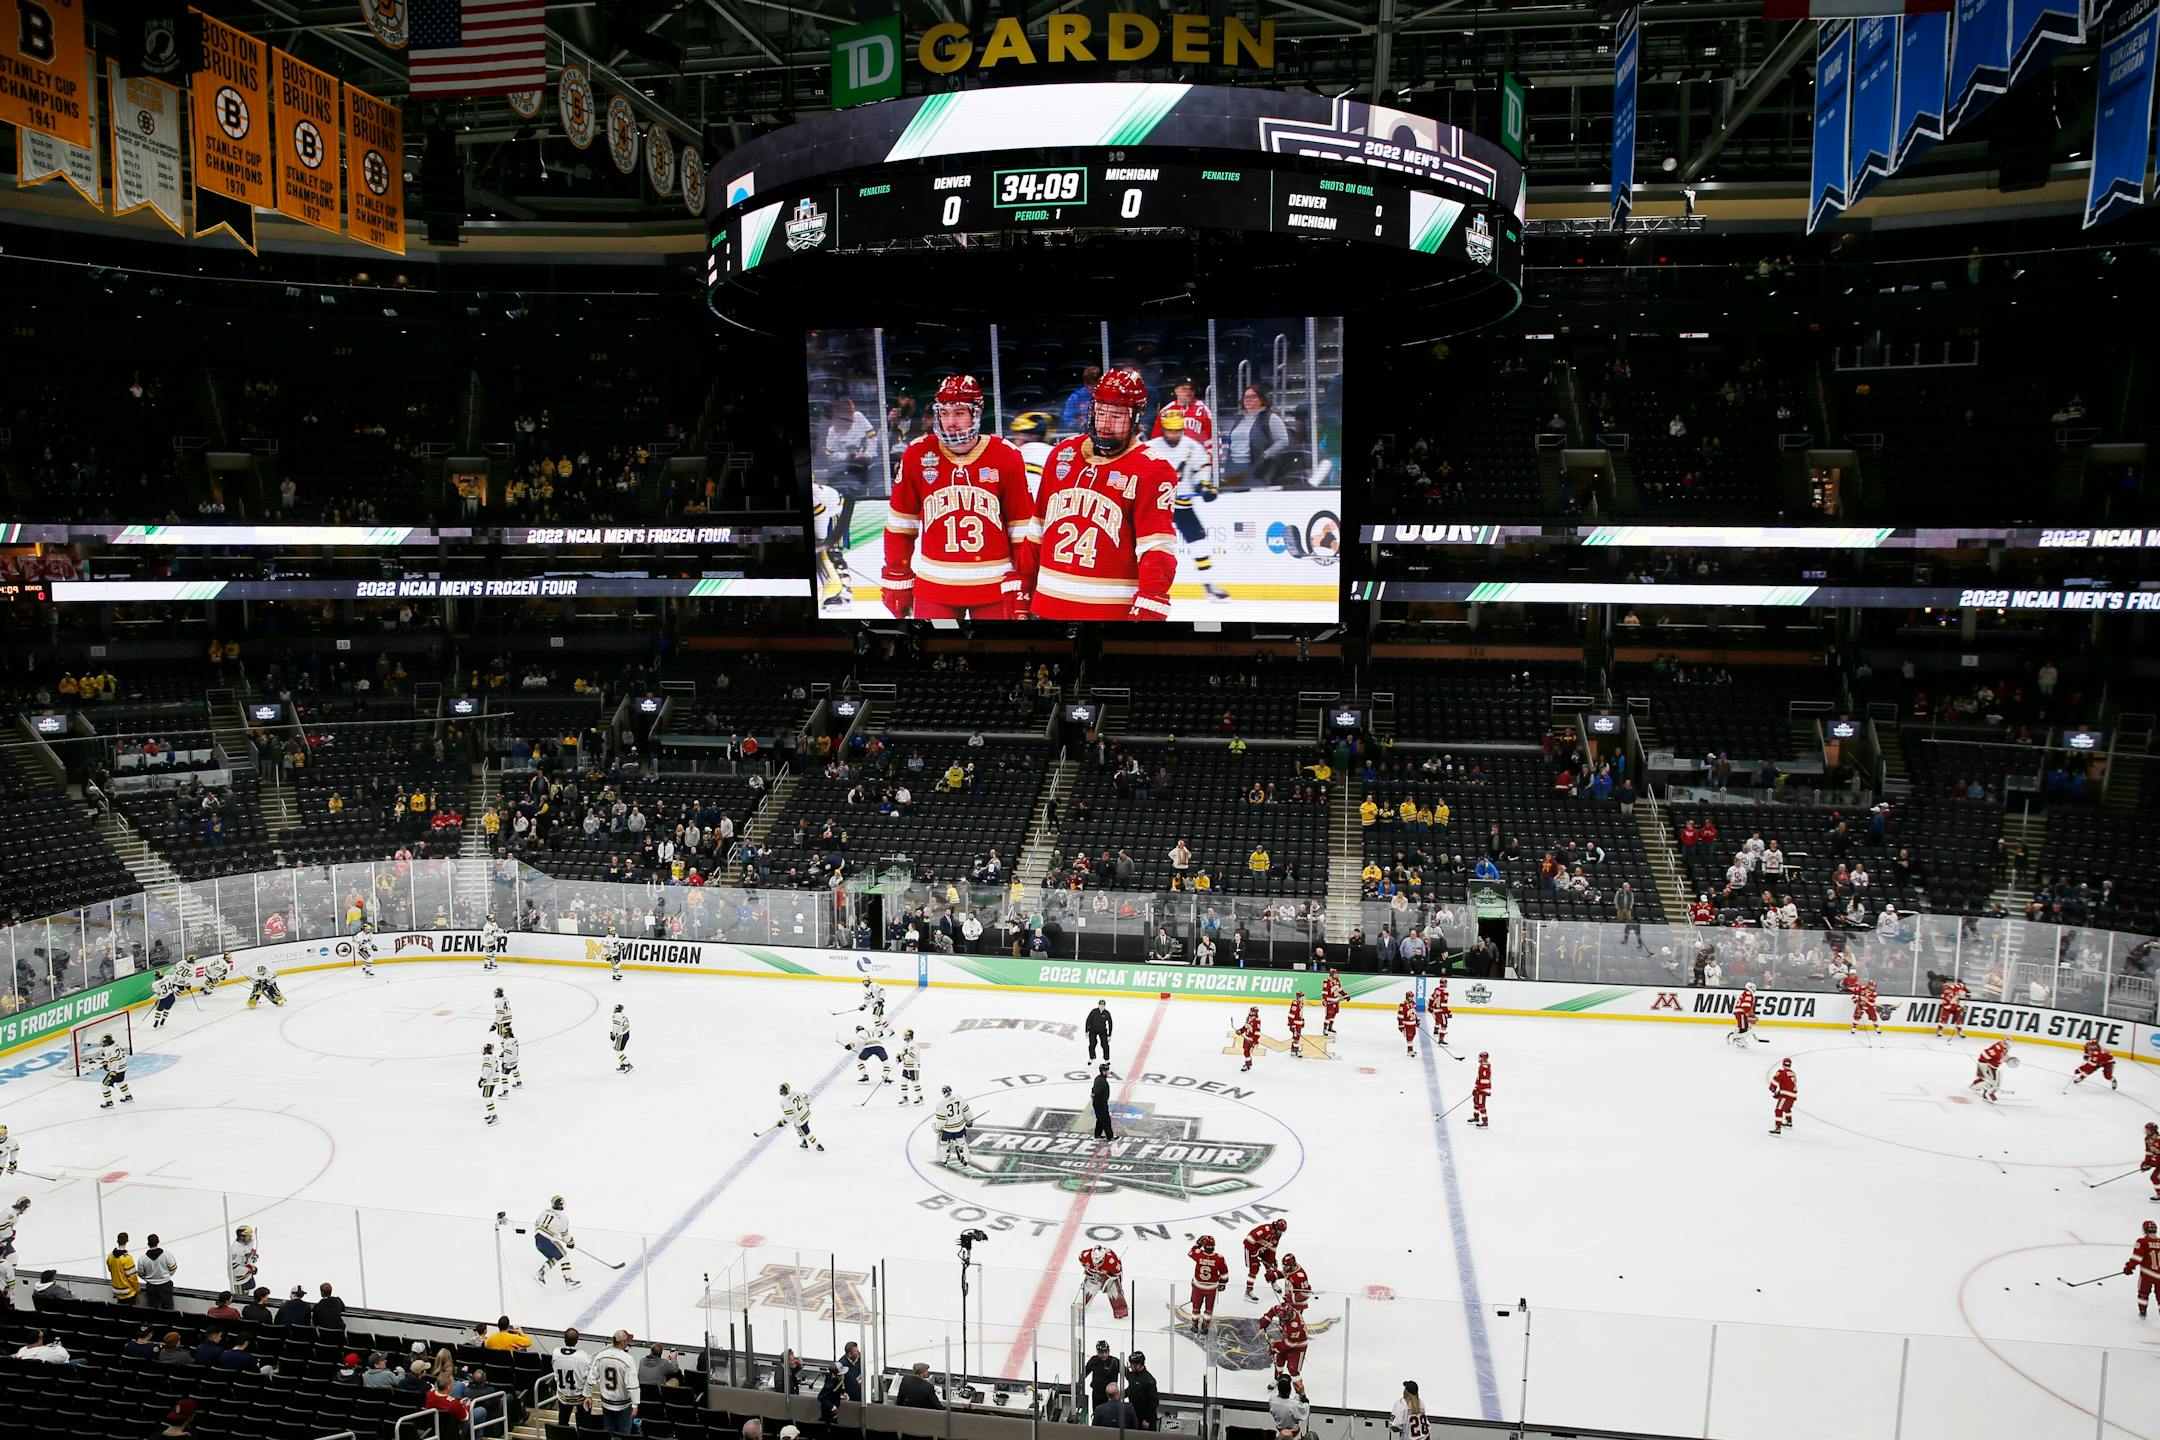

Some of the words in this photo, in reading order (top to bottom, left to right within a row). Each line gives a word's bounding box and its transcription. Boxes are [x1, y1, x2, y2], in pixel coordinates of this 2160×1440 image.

[201, 19, 257, 65] BOSTON
[836, 34, 894, 90] TD
[918, 12, 1275, 74] GARDEN
[0, 55, 53, 88] STANLEY
[56, 78, 77, 97] CUP
[201, 48, 258, 92] BRUINS
[282, 57, 331, 100] BOSTON
[0, 77, 79, 120] CHAMPIONS
[283, 86, 332, 125] BRUINS
[352, 92, 396, 130] BOSTON
[28, 107, 56, 131] 1941
[1504, 85, 1522, 143] TD
[353, 116, 396, 153] BRUINS
[206, 136, 245, 161] STANLEY
[246, 149, 261, 167] CUP
[1364, 142, 1401, 160] 2022
[1403, 149, 1441, 169] MEN'S
[206, 155, 263, 185] CHAMPIONS
[286, 165, 319, 193] STANLEY
[320, 178, 334, 193] CUP
[934, 175, 972, 190] DENVER
[1105, 168, 1159, 181] MICHIGAN
[1202, 170, 1240, 181] PENALTIES
[225, 177, 247, 197] 1970
[286, 182, 335, 212] CHAMPIONS
[859, 184, 890, 197] PENALTIES
[1002, 173, 1079, 202] 34:09
[1320, 180, 1345, 191] SHOTS
[1345, 183, 1356, 193] ON
[1356, 184, 1374, 196] GOAL
[302, 204, 320, 222] 1972
[356, 193, 383, 217] STANLEY
[384, 205, 398, 218] CUP
[942, 196, 961, 227] 0
[1015, 210, 1050, 221] PERIOD:
[1055, 207, 1061, 220] 1
[1121, 189, 1143, 219] 0
[1289, 194, 1327, 210] DENVER
[1375, 205, 1383, 218] 0
[356, 209, 399, 235] CHAMPIONS
[1289, 214, 1337, 231] MICHIGAN
[1375, 225, 1382, 237] 0
[370, 228, 386, 244] 2011
[1122, 475, 1138, 500] A
[923, 485, 1003, 533] DENVER
[1044, 487, 1123, 549] DENVER
[527, 530, 563, 544] 2022
[566, 529, 601, 544] NCAA
[604, 529, 645, 544] MEN'S
[648, 528, 695, 543] FROZEN
[697, 528, 731, 542] FOUR
[944, 516, 984, 552] 13
[1054, 522, 1098, 568] 24
[2039, 530, 2090, 547] 2022
[2092, 530, 2142, 547] NCAA
[357, 582, 397, 597] 2022
[399, 581, 437, 596] NCAA
[440, 581, 483, 596] MEN'S
[485, 580, 538, 595] FROZEN
[541, 580, 577, 595] FOUR
[1016, 592, 1031, 600] 24
[1960, 590, 2011, 608] 2022
[2013, 591, 2061, 609] NCAA
[2063, 591, 2124, 610] MEN'S
[395, 935, 434, 954] DENVER
[441, 935, 508, 953] DENVR
[621, 943, 702, 965] MICHIGAN
[177, 966, 188, 977] 20
[1039, 966, 1081, 984] 2022
[1085, 967, 1126, 986] NCAA
[1132, 971, 1182, 989] MEN'S
[1186, 973, 1249, 993] FROZEN
[1252, 976, 1294, 994] FOUR
[160, 981, 173, 994] 34
[21, 1003, 73, 1038] FROZEN
[76, 991, 110, 1018] FOUR
[1650, 991, 1684, 1012] M
[1693, 993, 1816, 1018] MINESOTA
[950, 1018, 1079, 1041] DENVER
[2048, 1015, 2124, 1046] STATE
[991, 1074, 1047, 1090] TD
[1064, 1070, 1257, 1101] GARDEN
[946, 1101, 961, 1117] 37
[968, 1131, 1135, 1160] FROZEN
[1135, 1144, 1249, 1166] FOUR
[1060, 1160, 1134, 1172] BOSTON
[543, 1214, 555, 1229] 11
[916, 1193, 1196, 1244] BOSTON,
[1212, 1200, 1291, 1231] MA
[558, 1369, 576, 1390] 14
[604, 1366, 618, 1391] 9
[1409, 1414, 1430, 1437] 28
